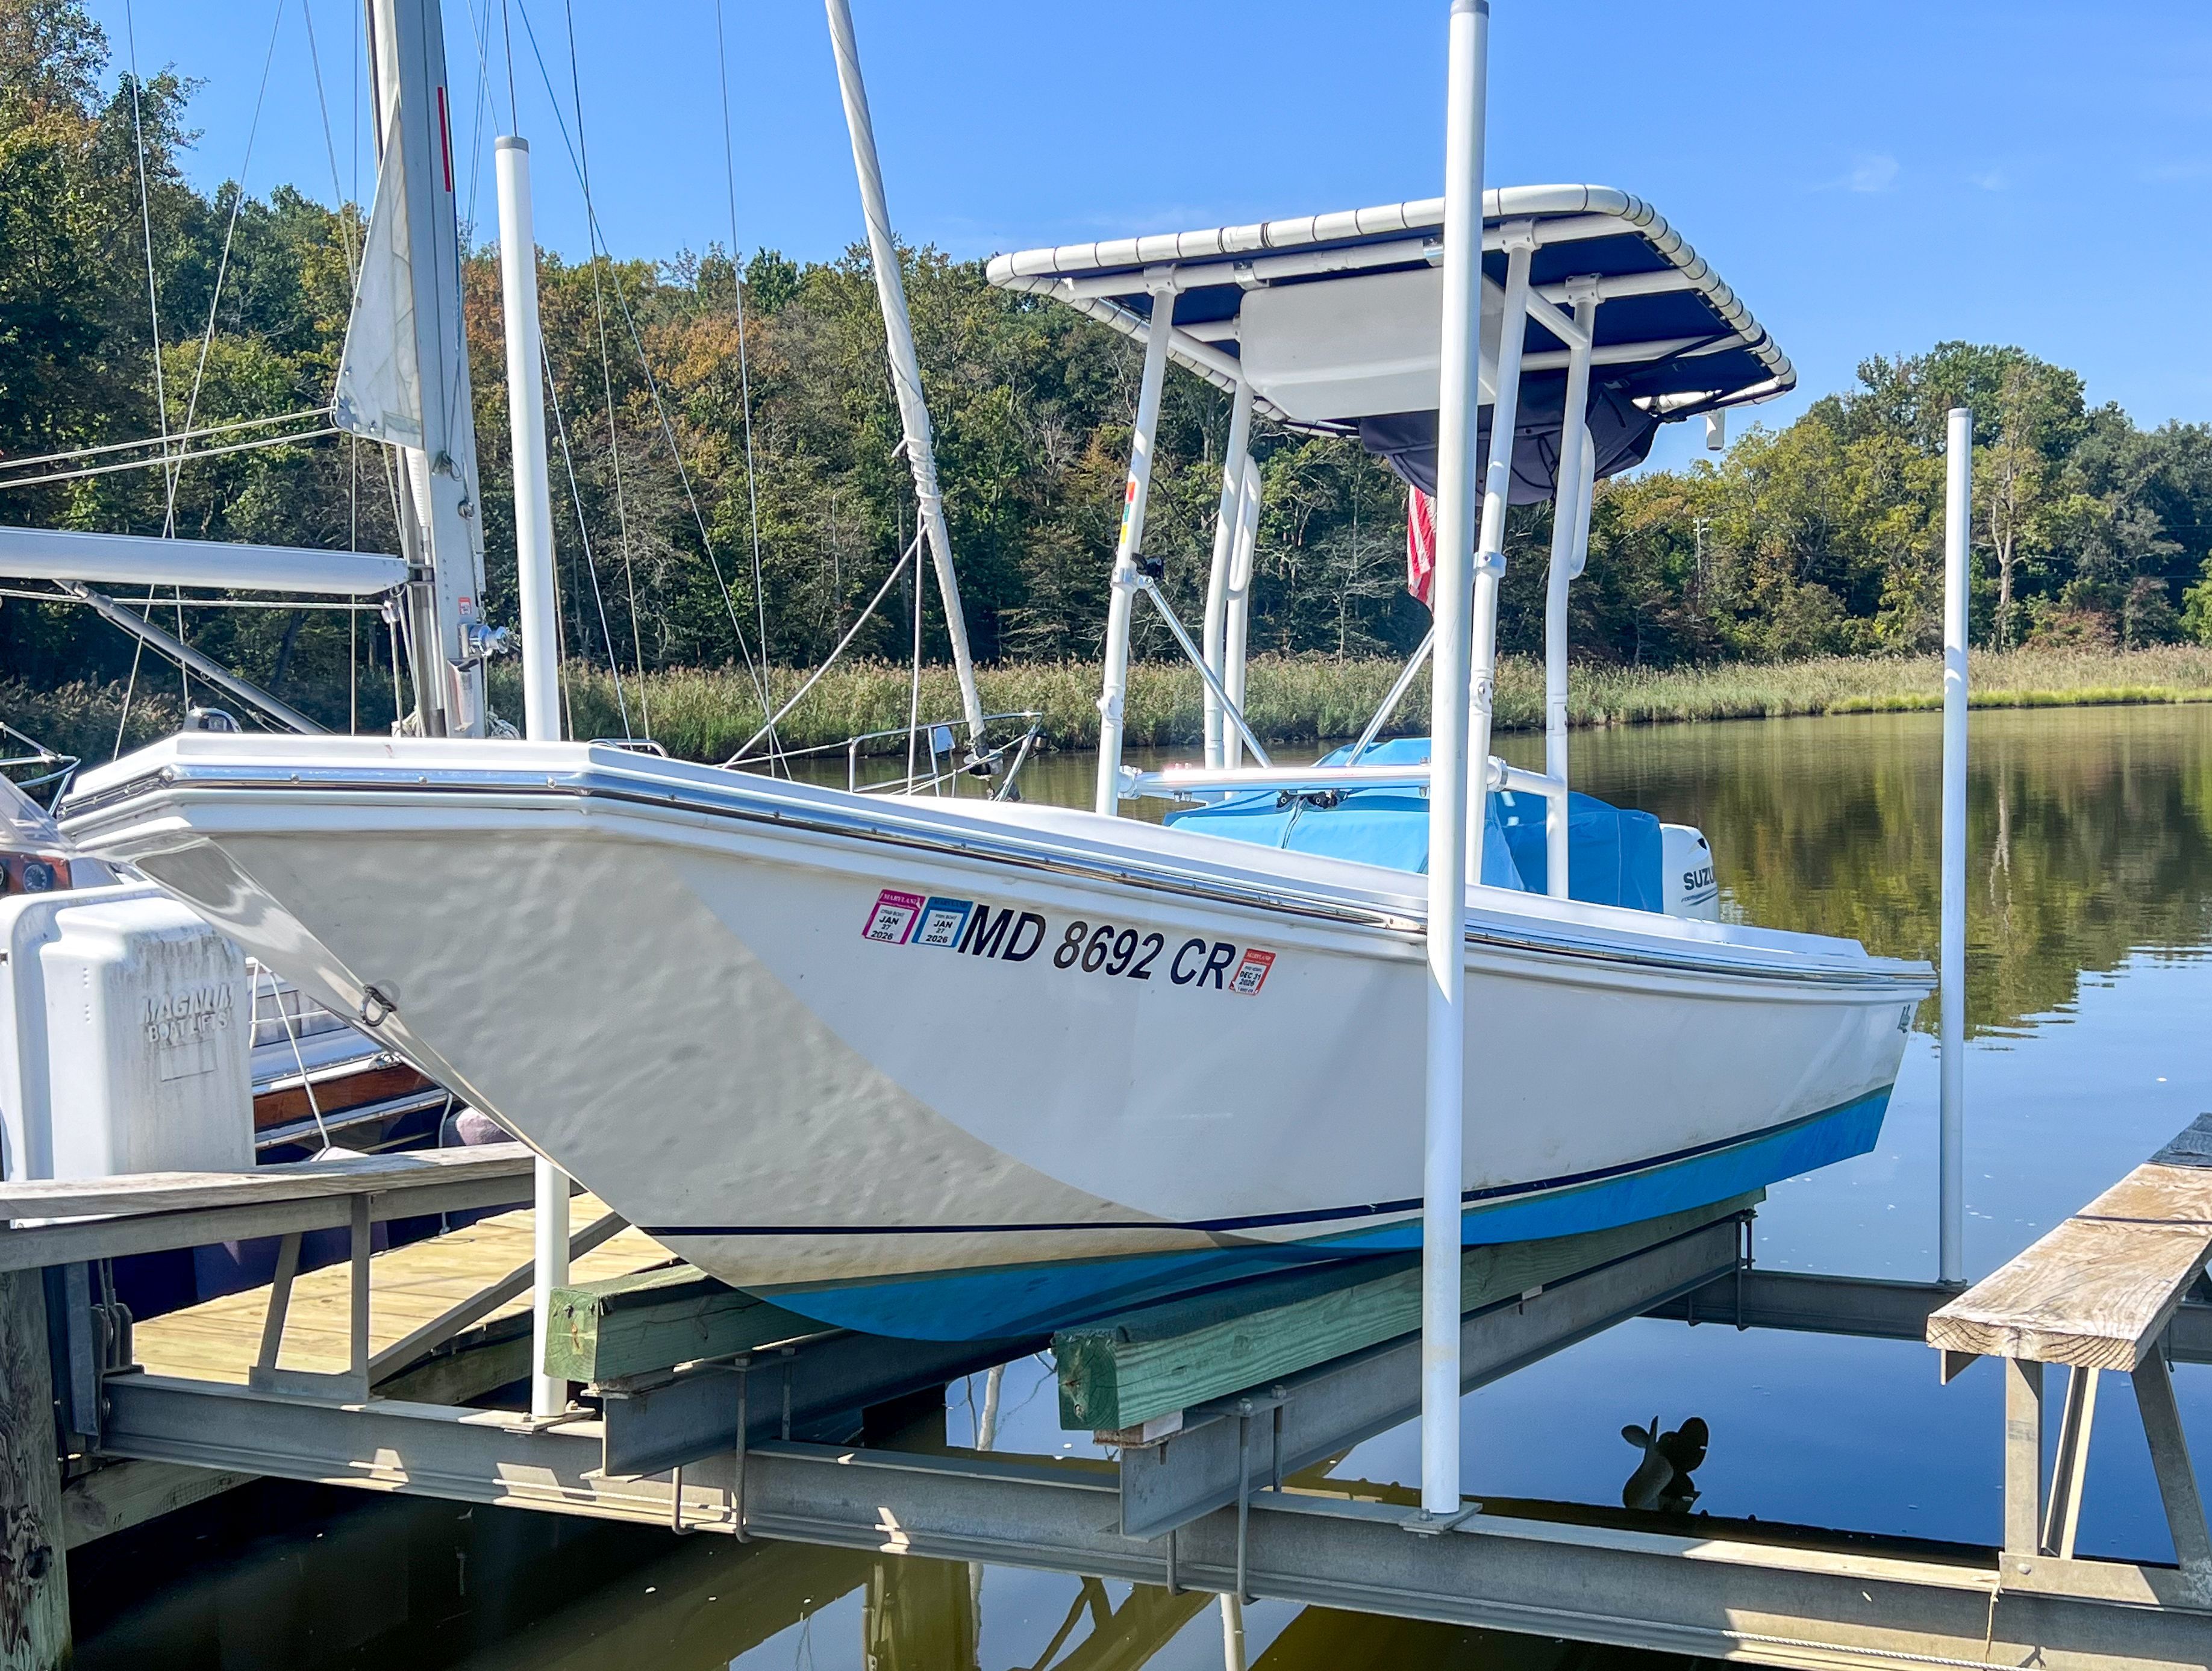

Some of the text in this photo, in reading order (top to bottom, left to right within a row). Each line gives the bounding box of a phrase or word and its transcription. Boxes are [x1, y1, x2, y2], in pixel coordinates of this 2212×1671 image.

[879, 916, 899, 925] JAN
[934, 920, 953, 928] JAN
[871, 930, 893, 940] 2026
[925, 934, 948, 943] 2026
[958, 904, 1236, 990] MD 8692 CR
[1240, 970, 1253, 979] DEC
[143, 982, 234, 1023] MAGNUM
[148, 1011, 228, 1043] BOAT LIFTS
